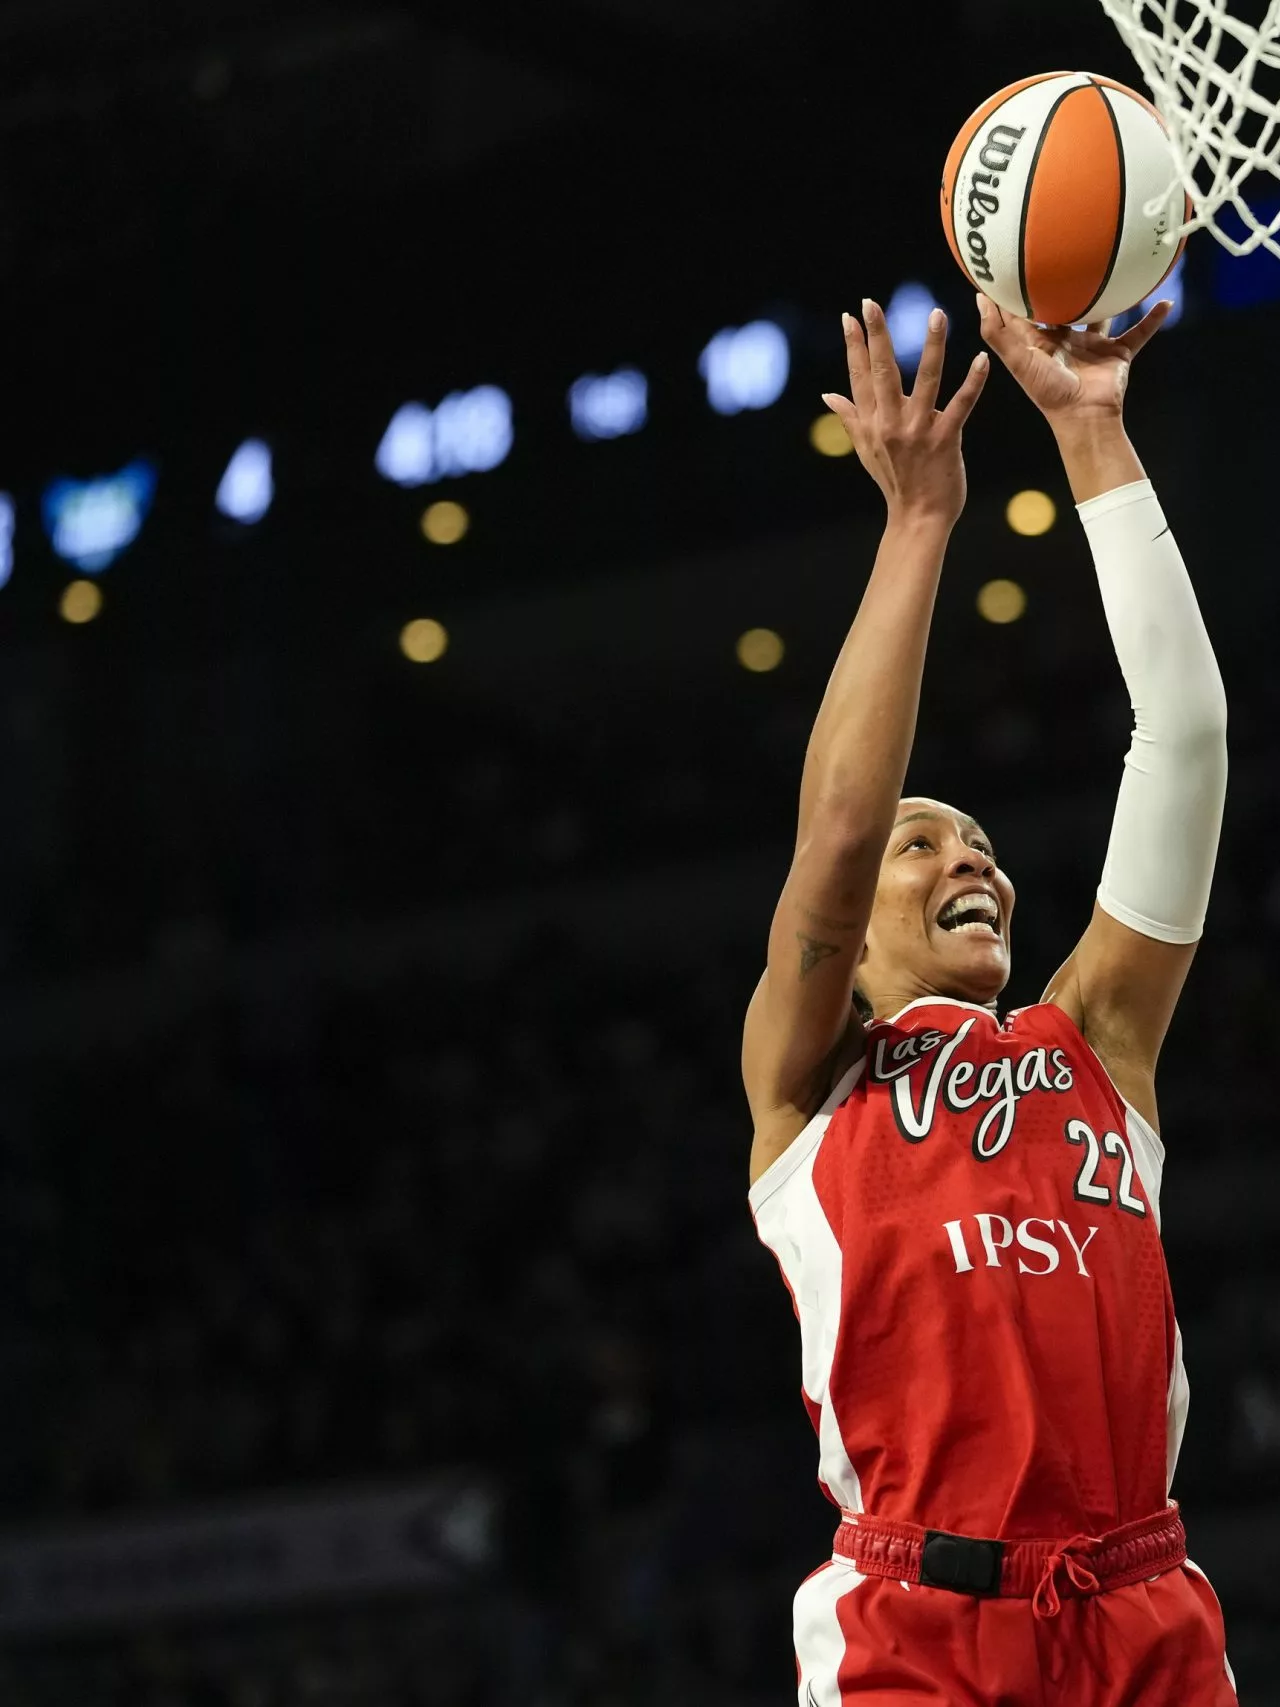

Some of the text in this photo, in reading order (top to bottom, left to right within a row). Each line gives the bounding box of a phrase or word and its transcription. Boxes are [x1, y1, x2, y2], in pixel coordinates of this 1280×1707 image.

[966, 123, 1027, 284] Wilson
[869, 1028, 947, 1083] Las
[889, 1017, 1075, 1163] Vegas
[1064, 1118, 1147, 1218] 22
[942, 1213, 1099, 1278] IPSY
